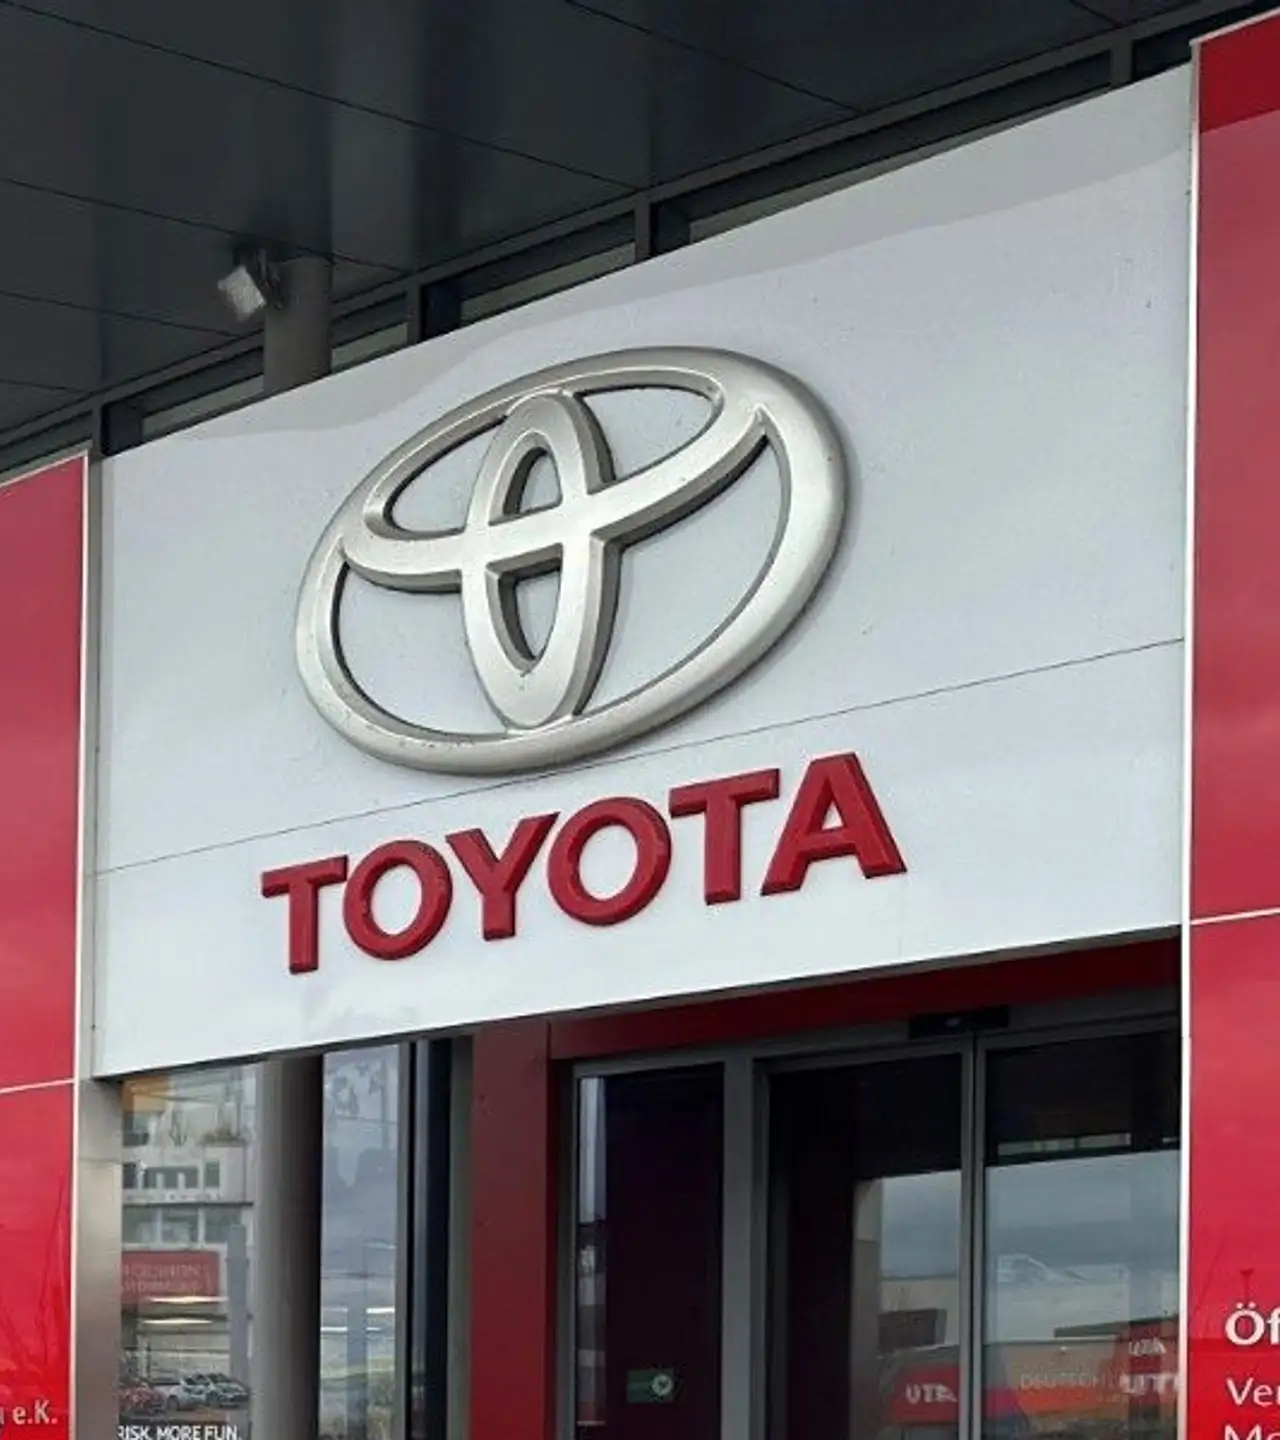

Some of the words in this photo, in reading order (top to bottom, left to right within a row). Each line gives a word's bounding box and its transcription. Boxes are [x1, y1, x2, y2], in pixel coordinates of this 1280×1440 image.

[260, 751, 907, 974] TOYOTA
[12, 1399, 58, 1425] e.K.
[156, 1425, 201, 1440] MORE
